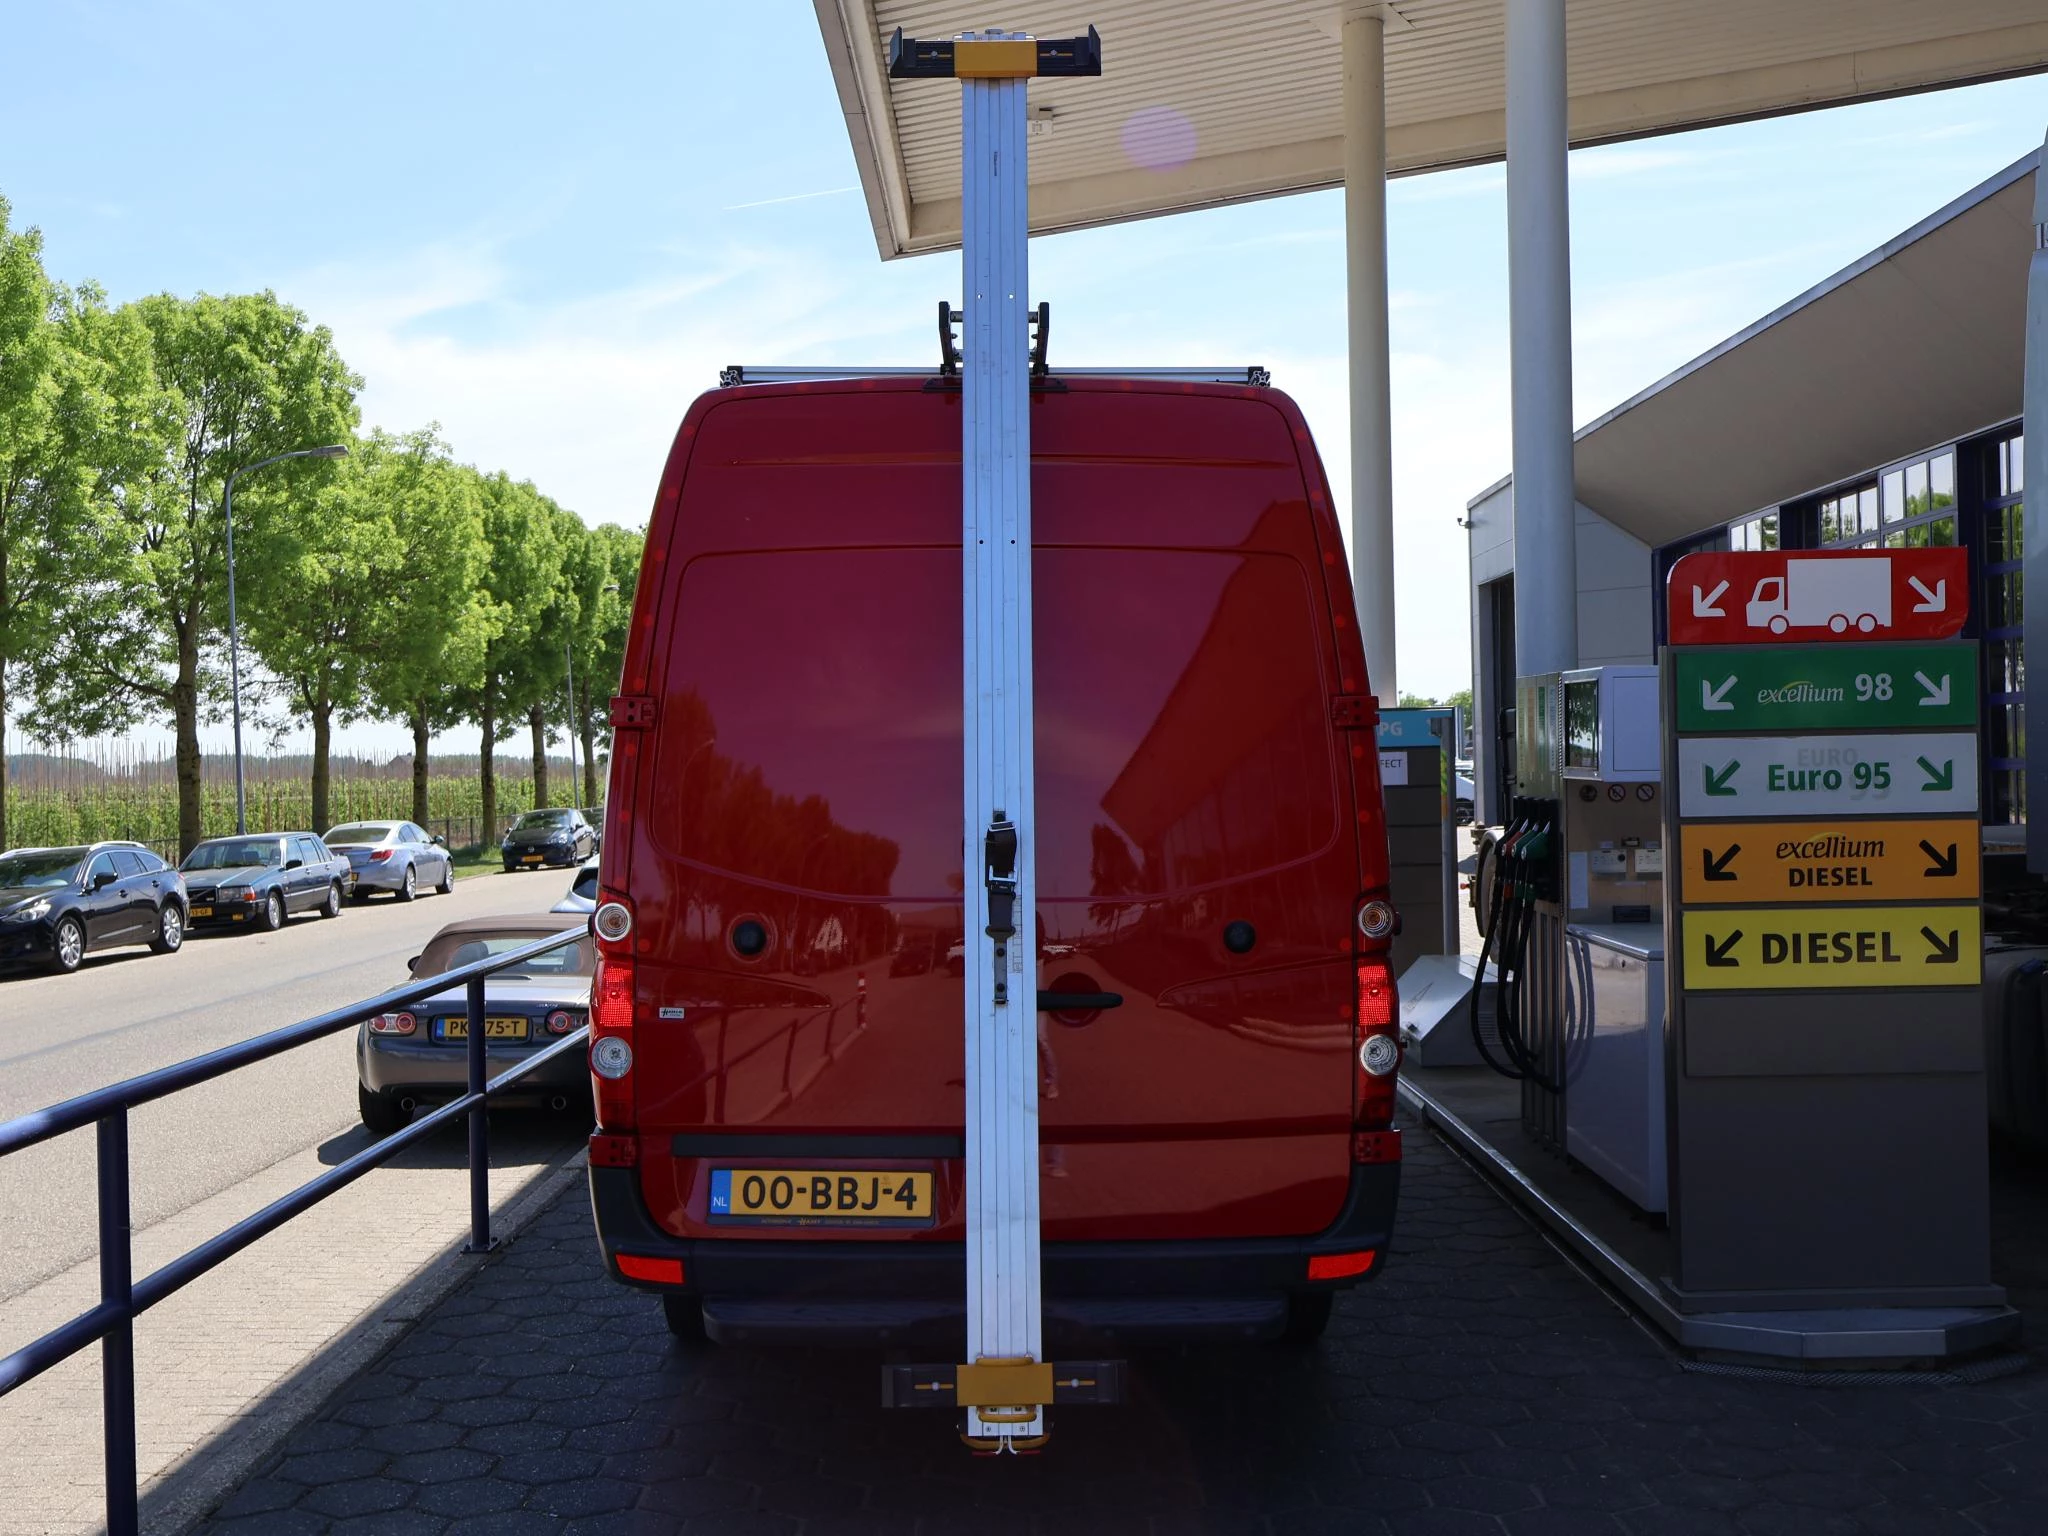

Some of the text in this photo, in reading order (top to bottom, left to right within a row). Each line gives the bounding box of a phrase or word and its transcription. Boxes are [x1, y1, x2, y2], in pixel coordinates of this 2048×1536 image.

[1757, 672, 1894, 705] excellium 98
[1379, 721, 1403, 736] PG
[1380, 759, 1402, 768] FECT
[1768, 764, 1842, 791] Euro
[1853, 762, 1891, 790] 95
[1776, 838, 1885, 861] excellium
[1789, 867, 1873, 887] DIESEL
[1761, 932, 1901, 965] DIESEL
[450, 1021, 520, 1035] PK75-T
[713, 1175, 917, 1211] NL 00-BBJ-4
